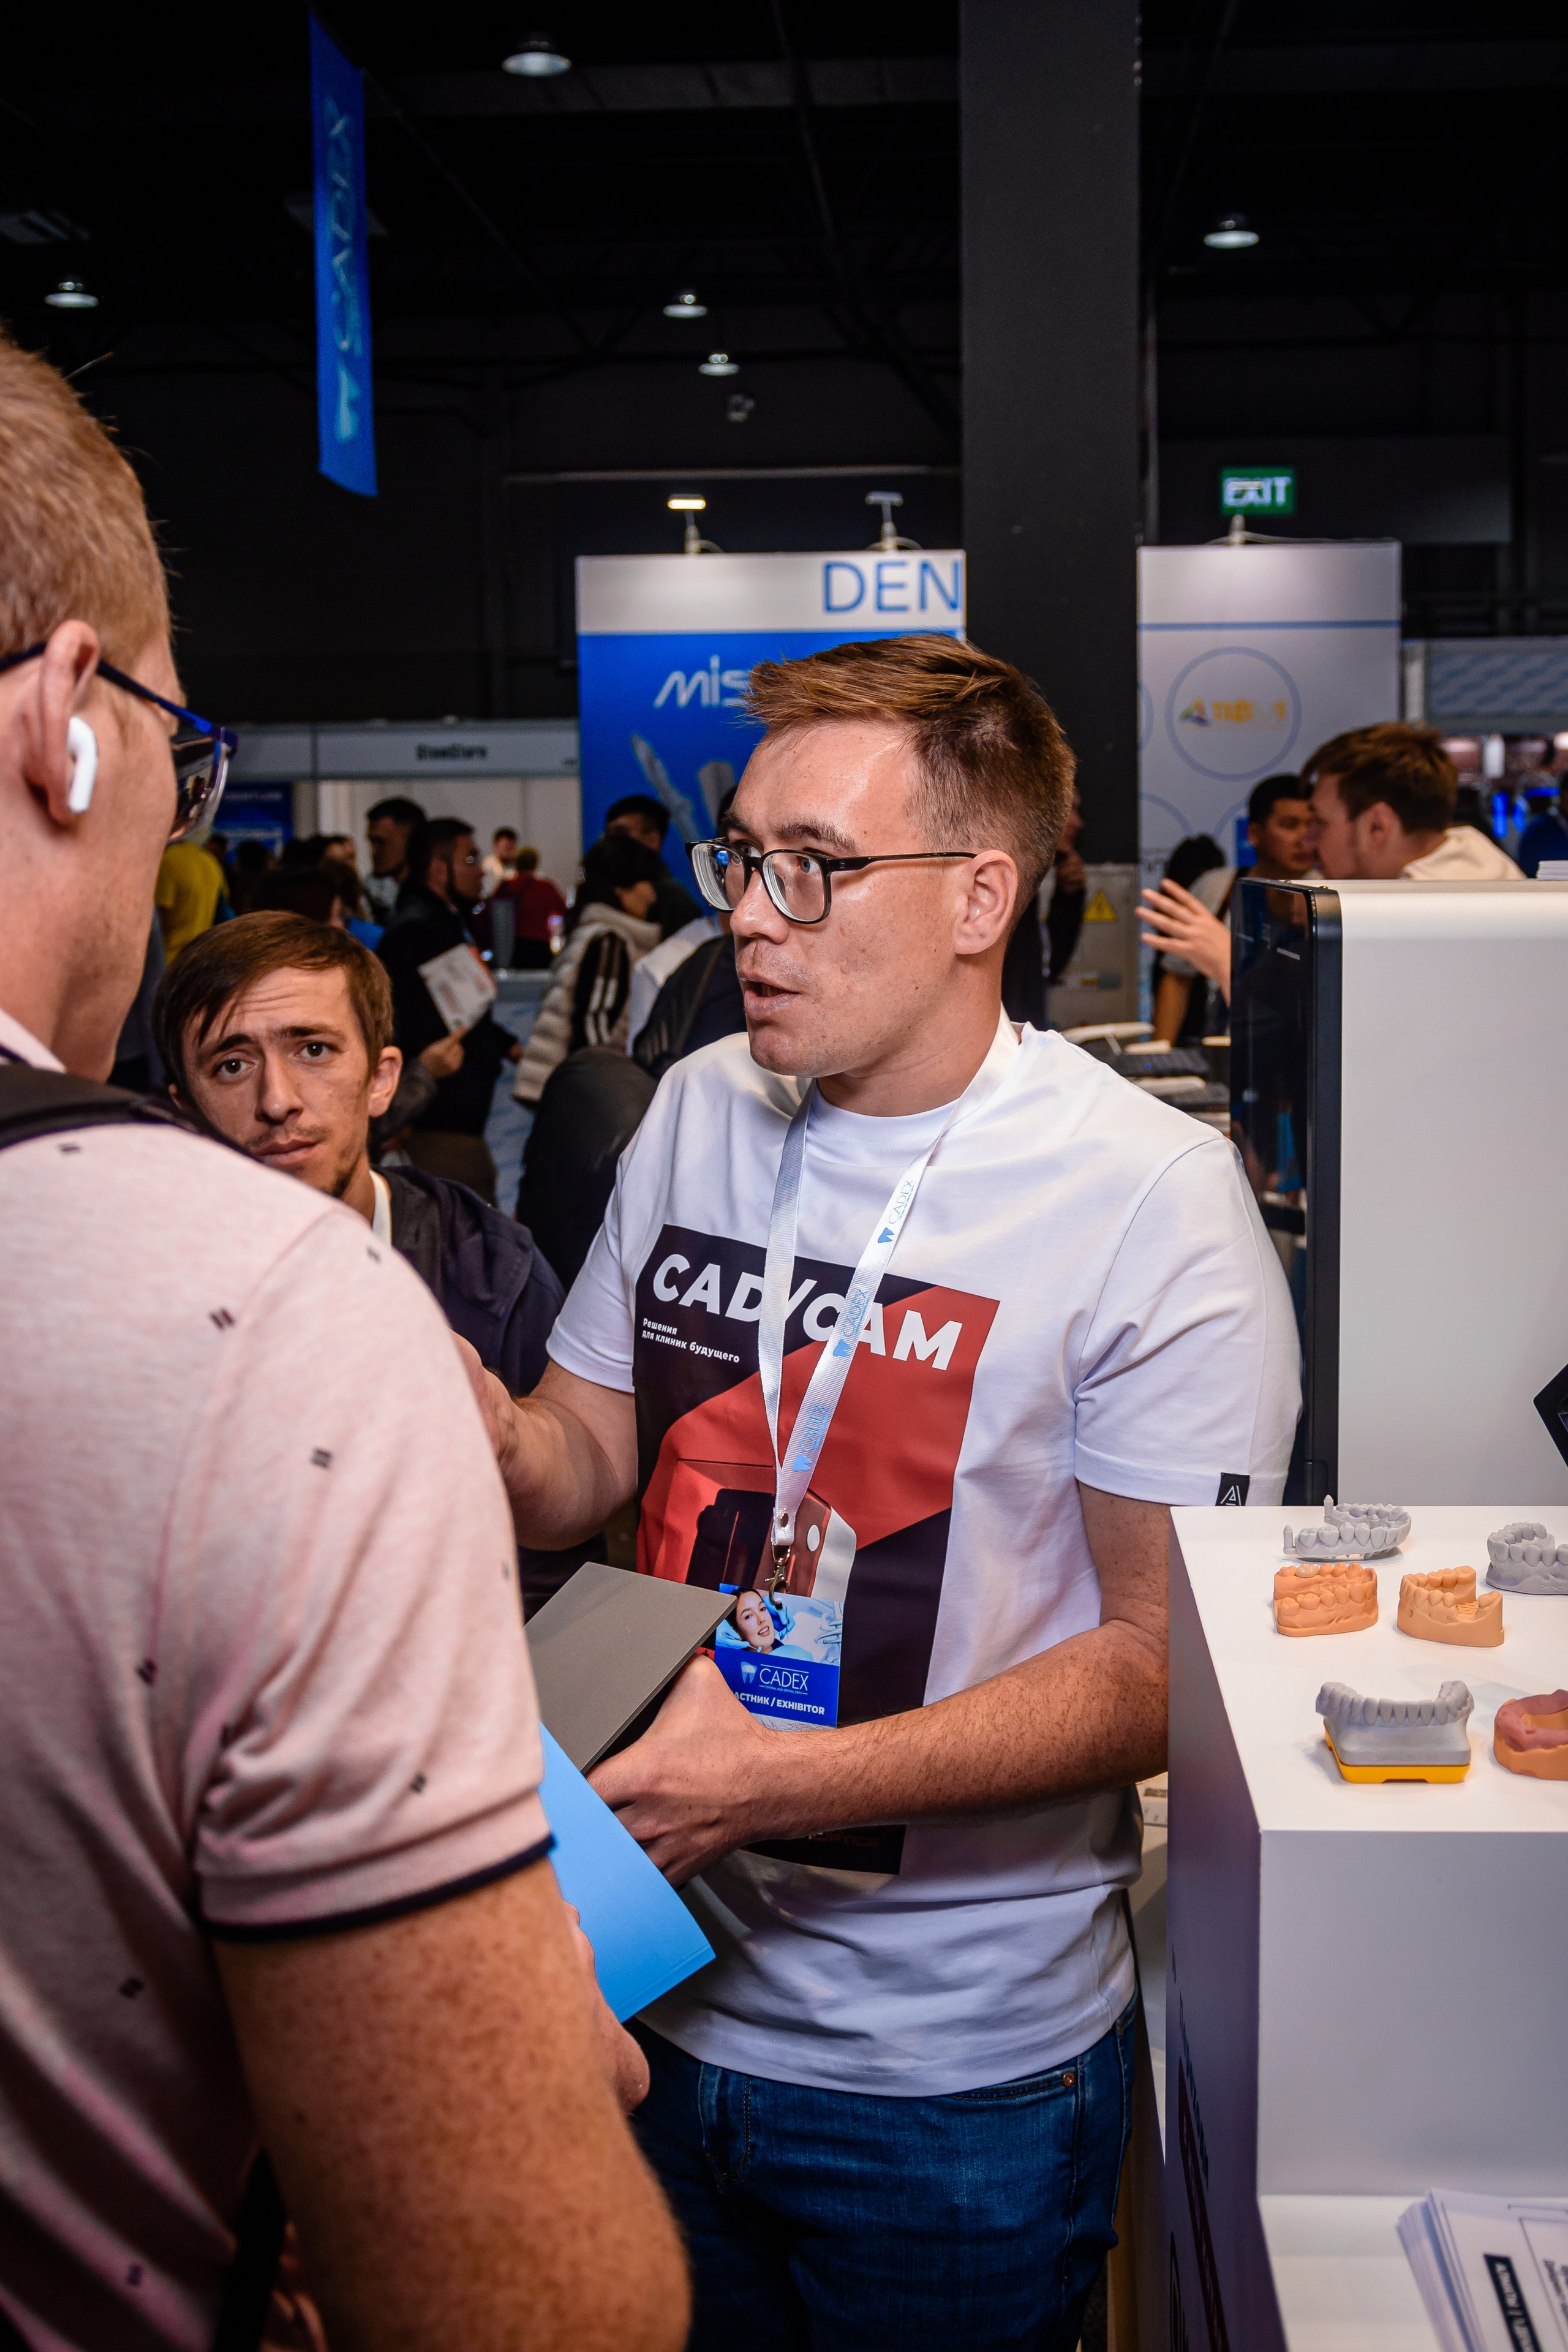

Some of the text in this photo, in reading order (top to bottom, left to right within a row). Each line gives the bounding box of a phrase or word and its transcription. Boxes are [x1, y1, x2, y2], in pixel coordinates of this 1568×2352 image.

[1223, 477, 1292, 507] EXIT
[823, 561, 960, 613] DEN
[889, 1180, 914, 1224] CADEX
[643, 1318, 677, 1335] Решения
[842, 1288, 869, 1336] CADEX
[642, 1330, 740, 1363] для клиник будущего
[799, 1402, 826, 1452] CADEX
[760, 1668, 809, 1691] CADEX
[734, 1691, 770, 1705] АСТНИК
[777, 1699, 825, 1715] EXHIBITOR
